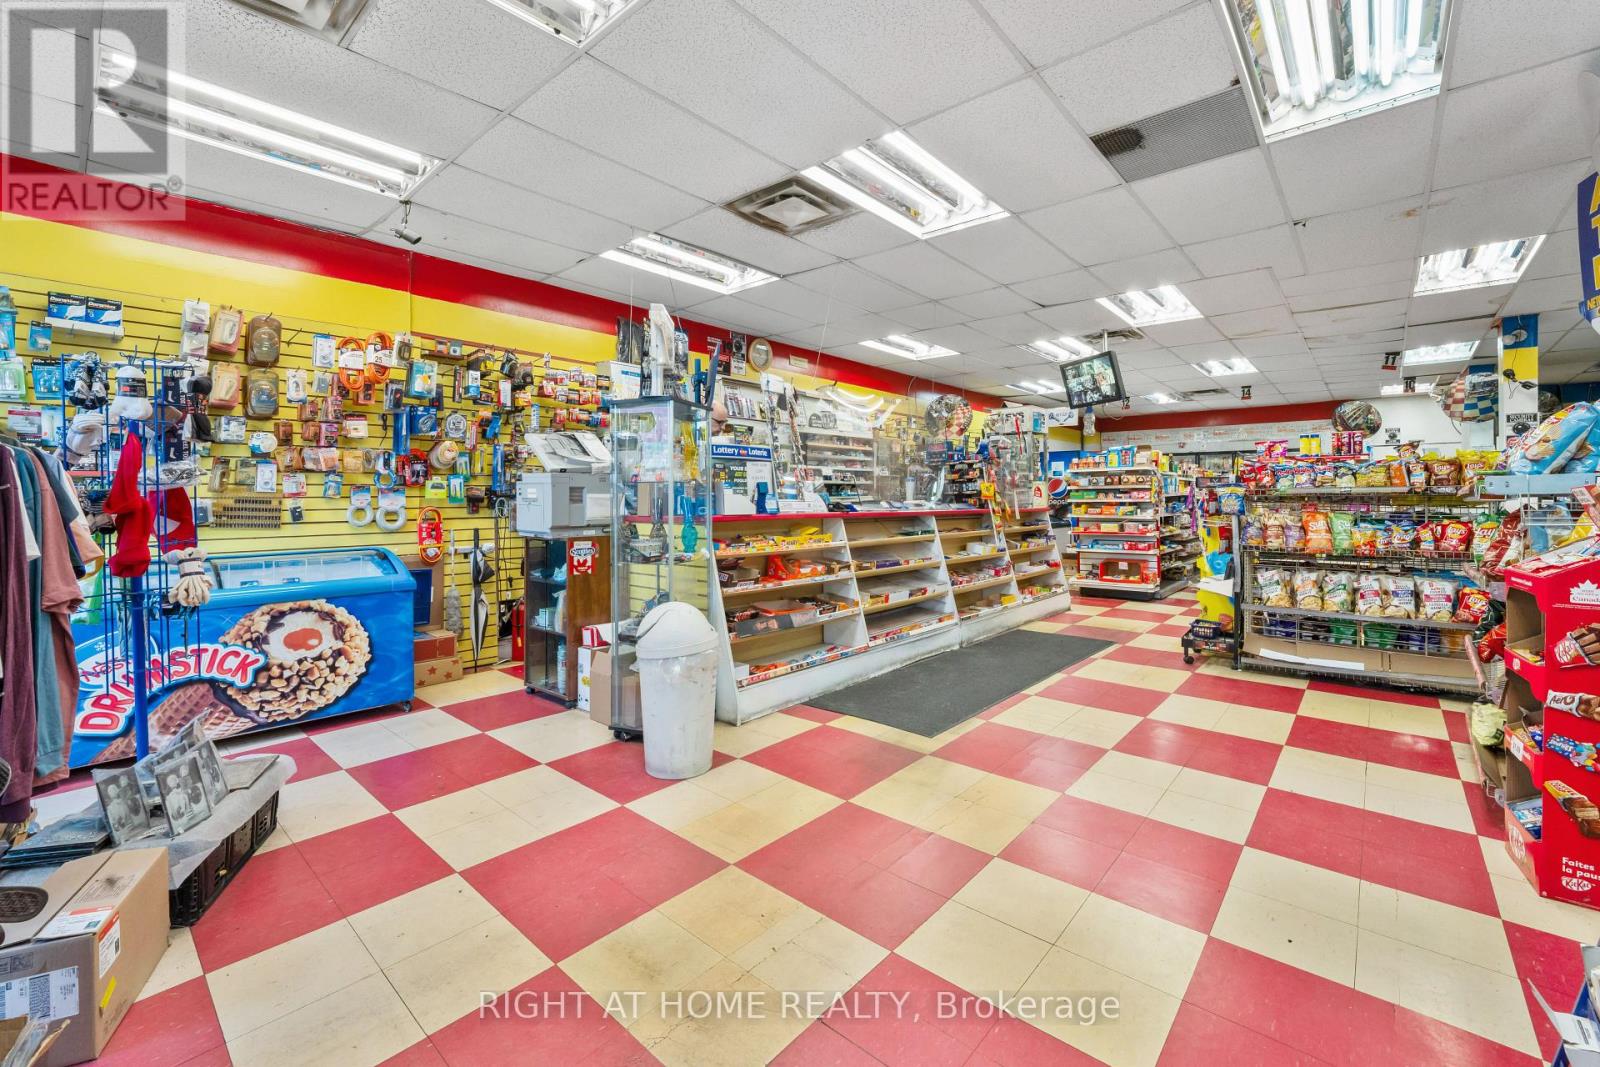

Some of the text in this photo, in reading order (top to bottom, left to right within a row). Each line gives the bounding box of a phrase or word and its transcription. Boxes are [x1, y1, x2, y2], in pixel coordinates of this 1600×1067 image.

[713, 445, 768, 456] Lottery Loterie
[1562, 856, 1595, 871] Faites
[1562, 864, 1573, 874] la
